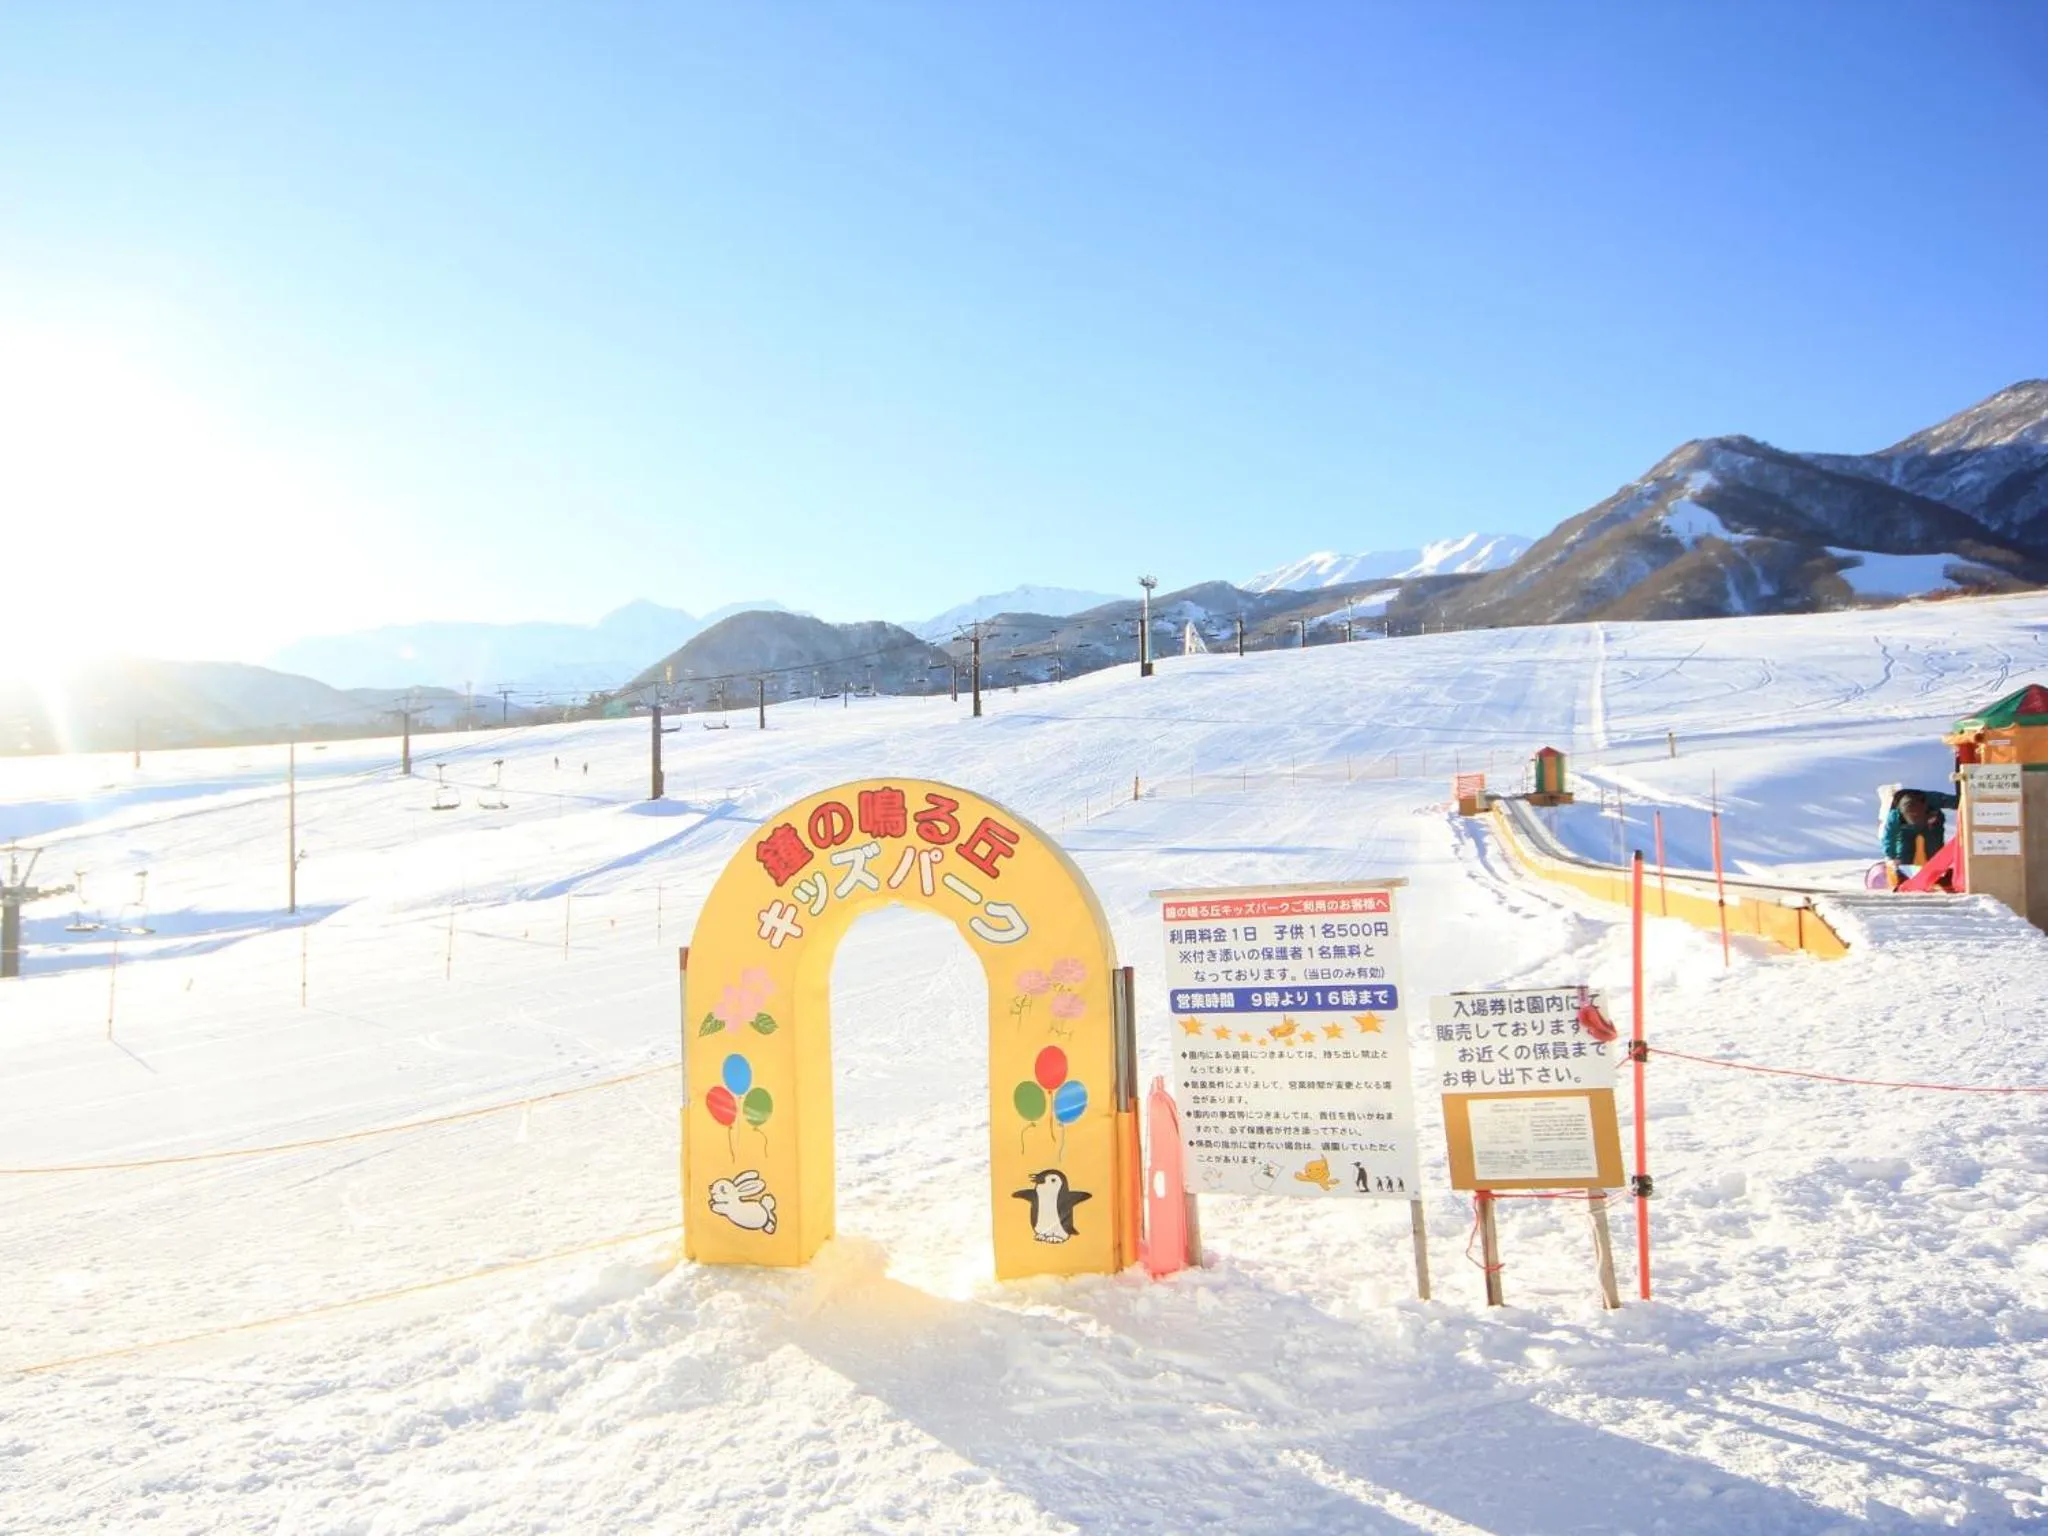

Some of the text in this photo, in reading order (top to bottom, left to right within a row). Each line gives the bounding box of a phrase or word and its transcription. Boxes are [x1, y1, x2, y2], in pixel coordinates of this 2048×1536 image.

[757, 841, 1029, 949] キッズパーク
[1176, 993, 1235, 1009] 営業時間
[1458, 1041, 1606, 1063] お近くの係員まで
[1190, 1064, 1255, 1075] なっております。
[1442, 1067, 1582, 1087] お申し出下さい。
